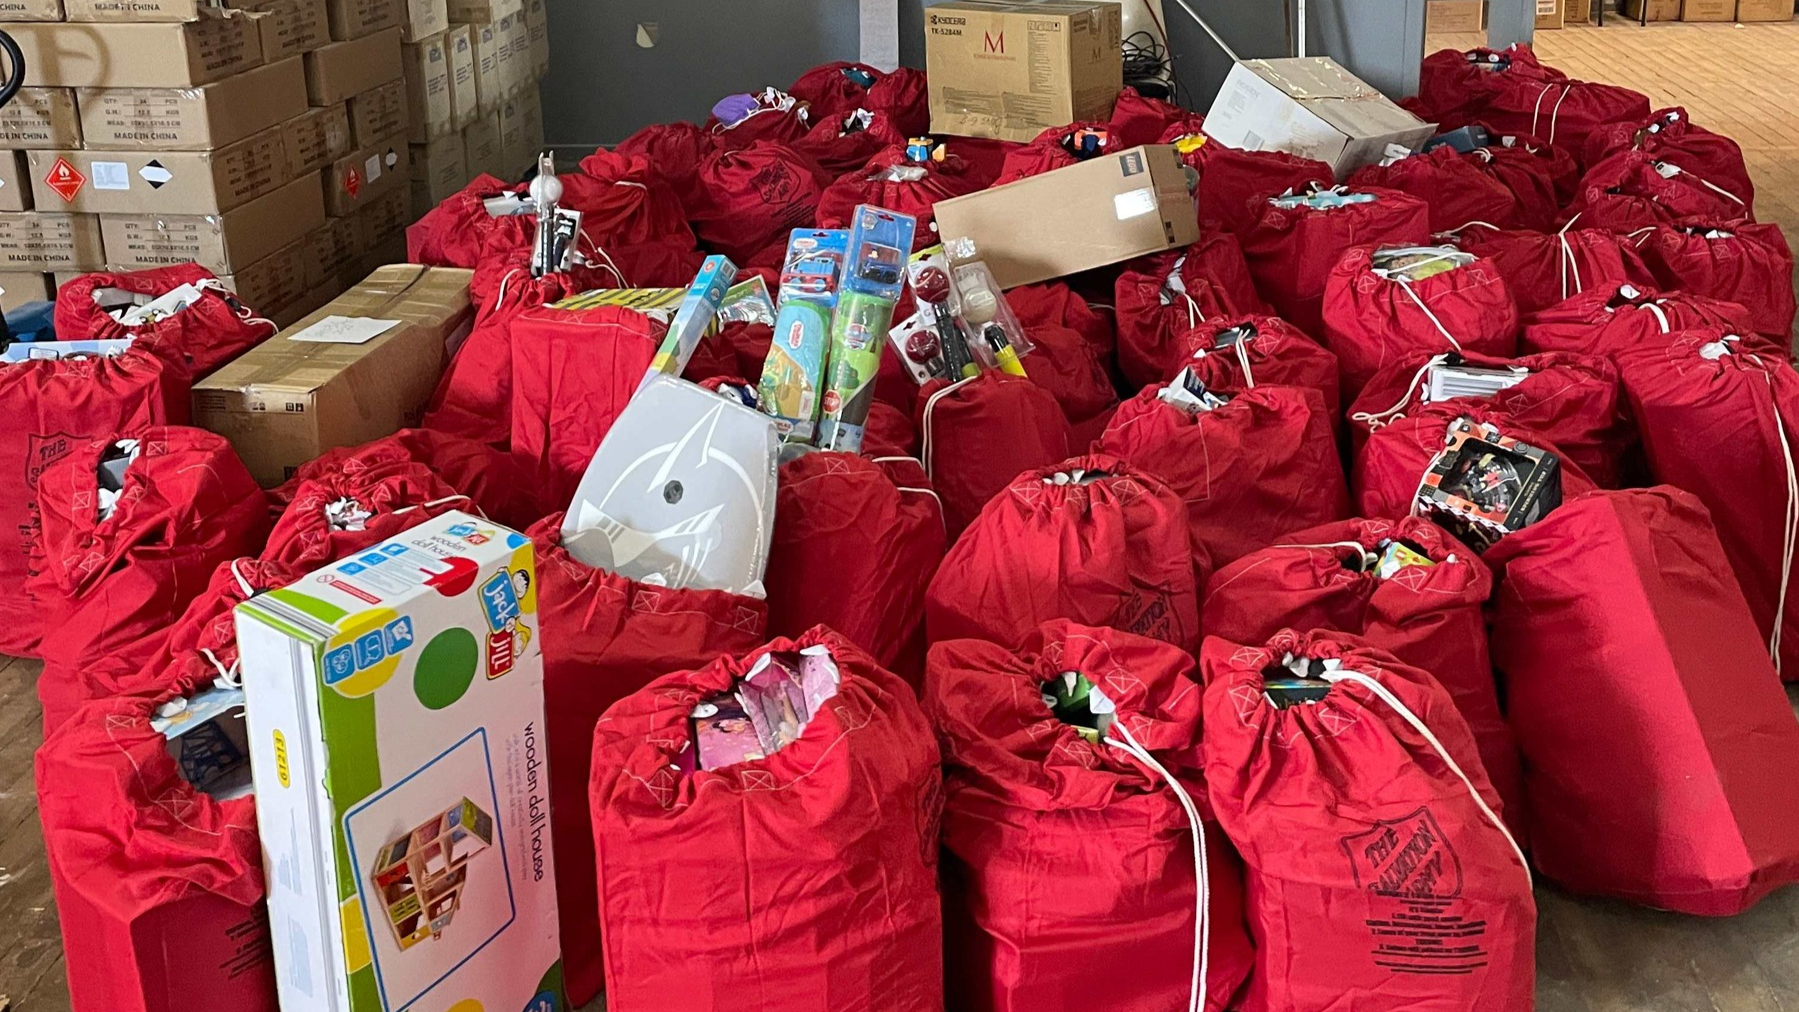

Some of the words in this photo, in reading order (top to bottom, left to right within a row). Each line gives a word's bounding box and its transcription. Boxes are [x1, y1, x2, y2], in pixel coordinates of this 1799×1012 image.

[938, 16, 967, 25] KYOCERA
[985, 31, 1004, 53] M
[22, 132, 48, 140] CHINA
[114, 132, 138, 140] MADE
[150, 132, 178, 140] CHINA
[1125, 155, 1138, 174] LEGO
[39, 439, 67, 461] THE
[411, 539, 434, 548] doll
[430, 535, 467, 552] wooden
[483, 580, 516, 624] jack
[524, 721, 542, 793] wooden
[529, 796, 546, 827] doll
[531, 823, 546, 883] house
[1364, 827, 1399, 869] THE
